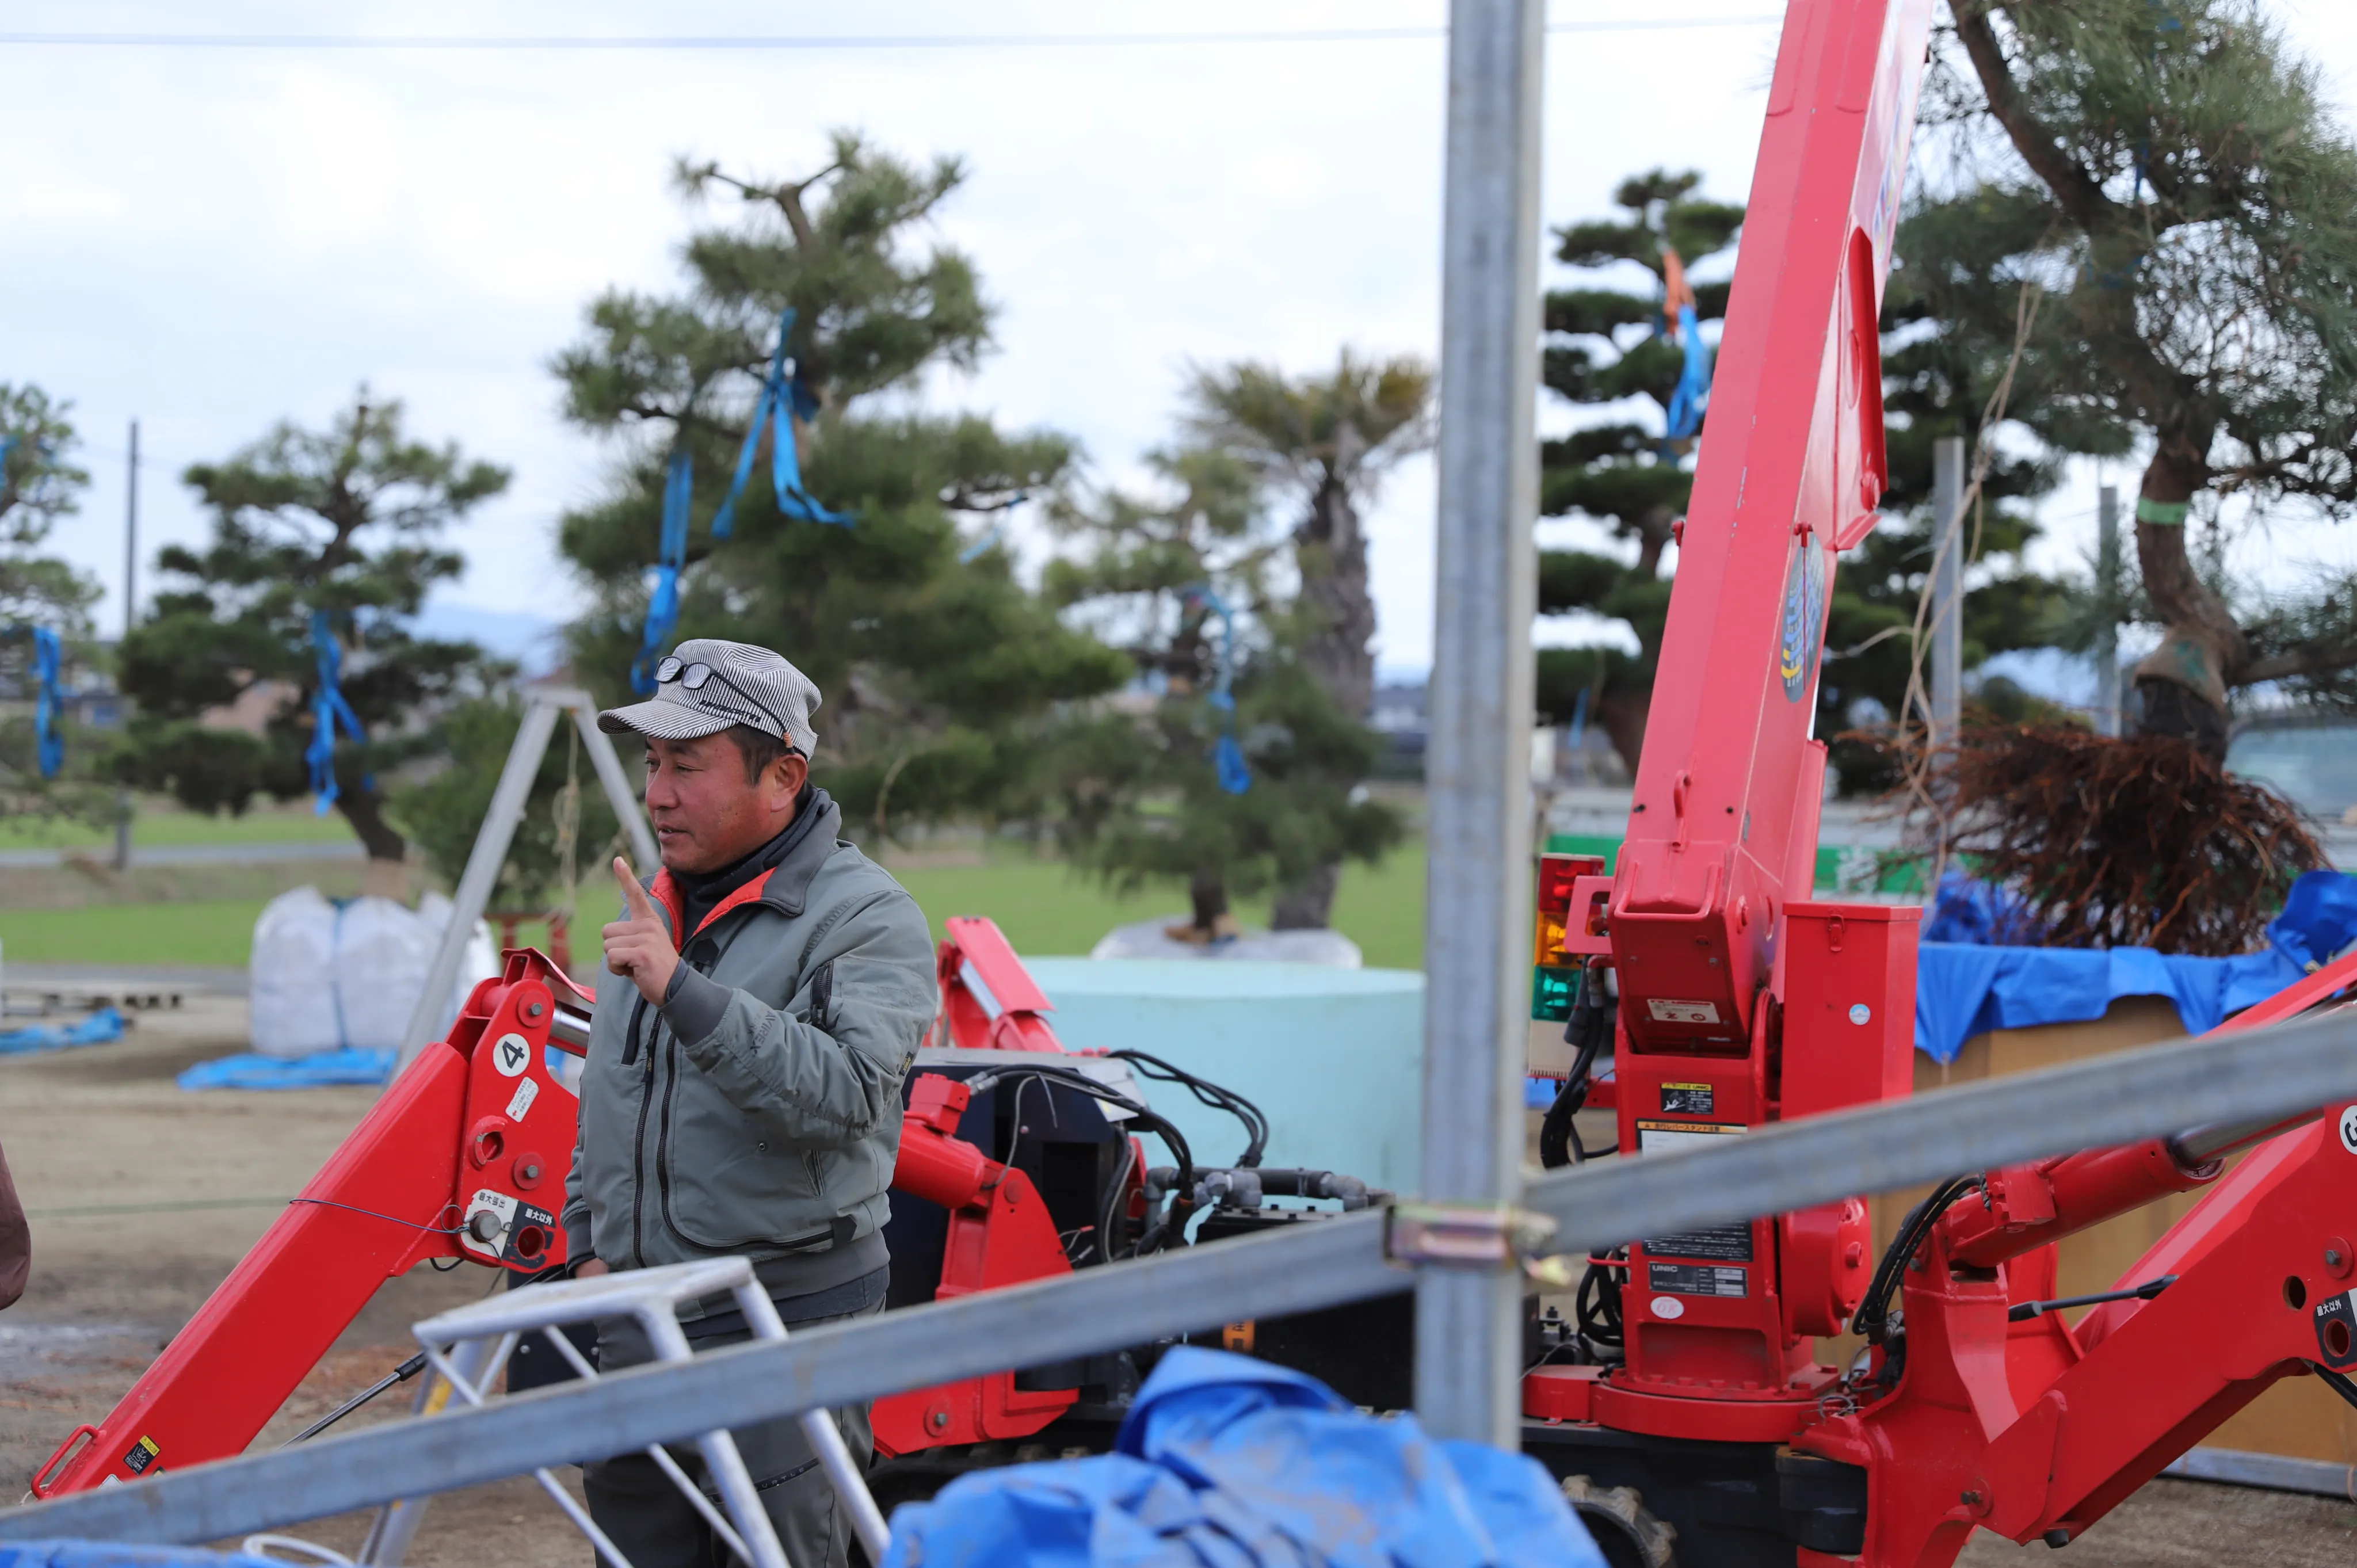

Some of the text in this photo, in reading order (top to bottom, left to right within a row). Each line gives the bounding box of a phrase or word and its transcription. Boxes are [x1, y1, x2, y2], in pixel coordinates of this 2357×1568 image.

[750, 1010, 776, 1058] AVIREX
[502, 1041, 525, 1069] 4
[525, 1208, 553, 1226] 最大以外
[1652, 1264, 1678, 1273] UNIC
[2317, 1299, 2341, 1317] 最大以外
[758, 1467, 804, 1489] URTLE
